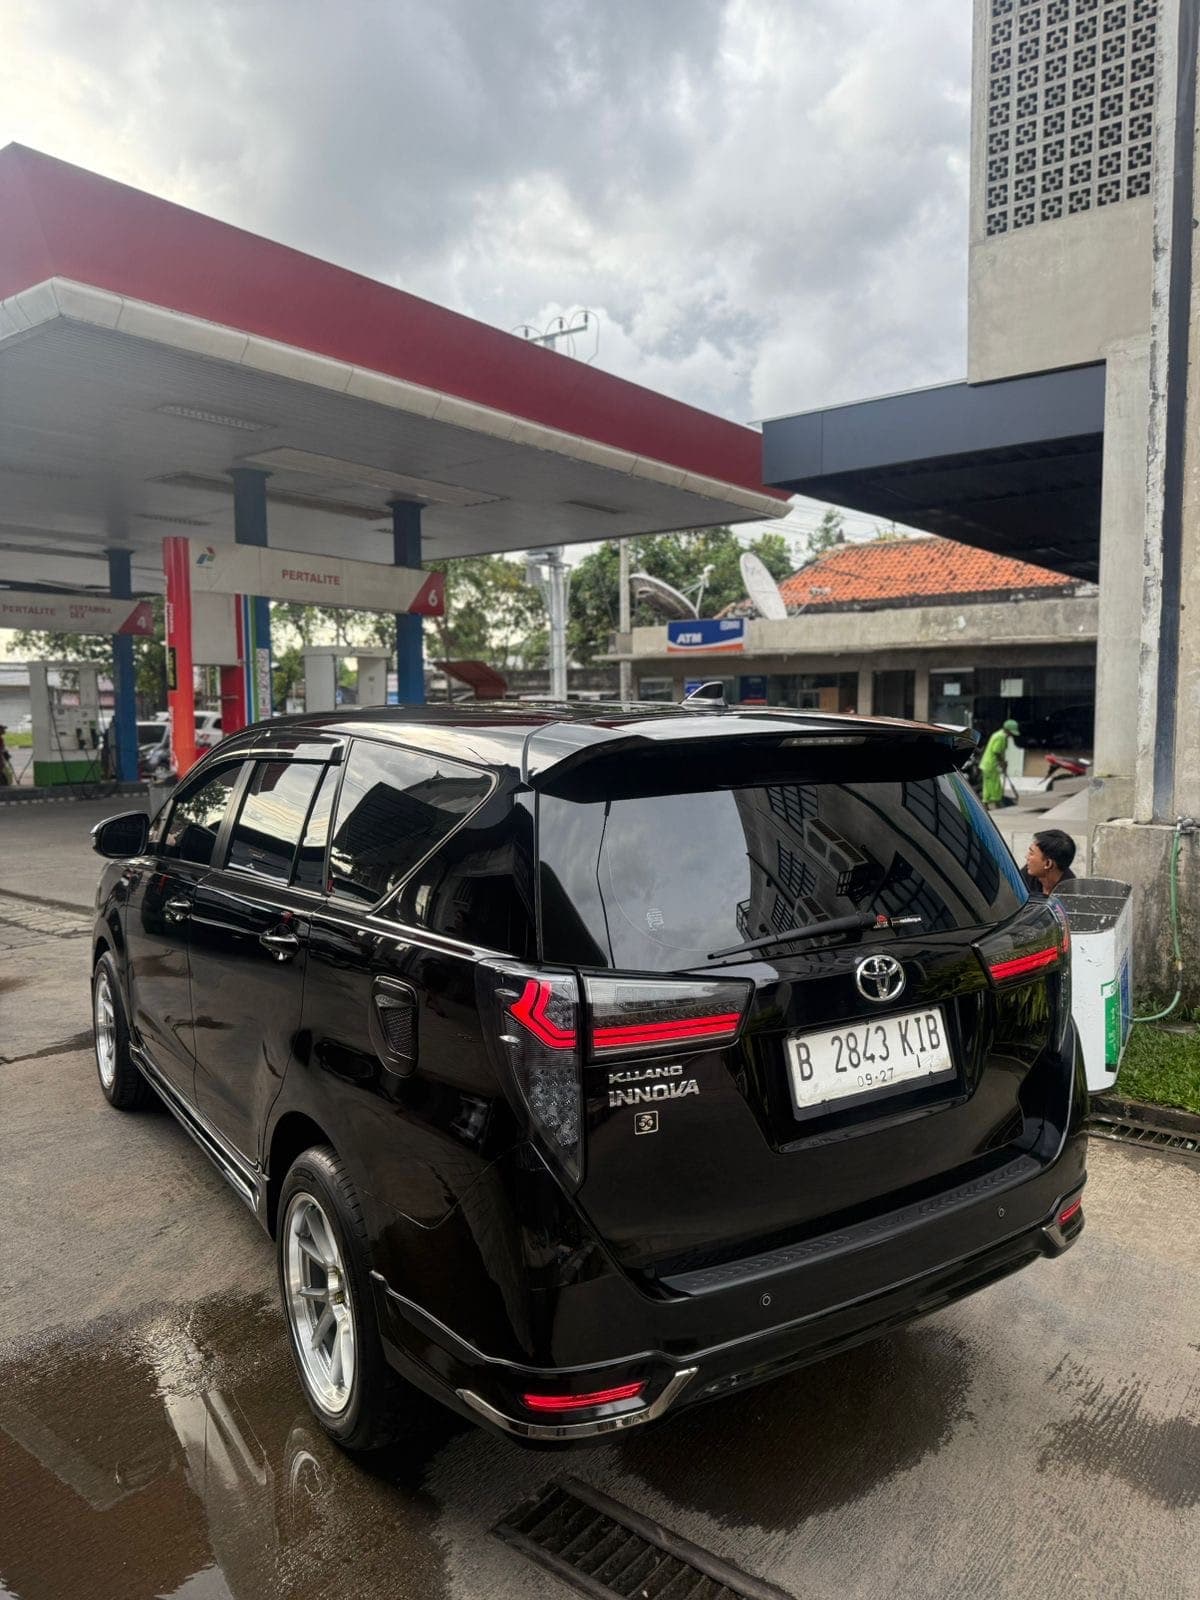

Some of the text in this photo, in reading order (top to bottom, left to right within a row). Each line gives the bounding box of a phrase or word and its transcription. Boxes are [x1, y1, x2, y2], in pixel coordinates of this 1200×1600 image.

[282, 569, 341, 586] PERTALITE
[428, 589, 438, 607] 6
[2, 604, 56, 616] PERTALITE
[137, 616, 147, 629] 4
[676, 632, 703, 644] ATM
[795, 1013, 941, 1081] B 2843 KIB
[608, 1079, 700, 1108] INNOVA
